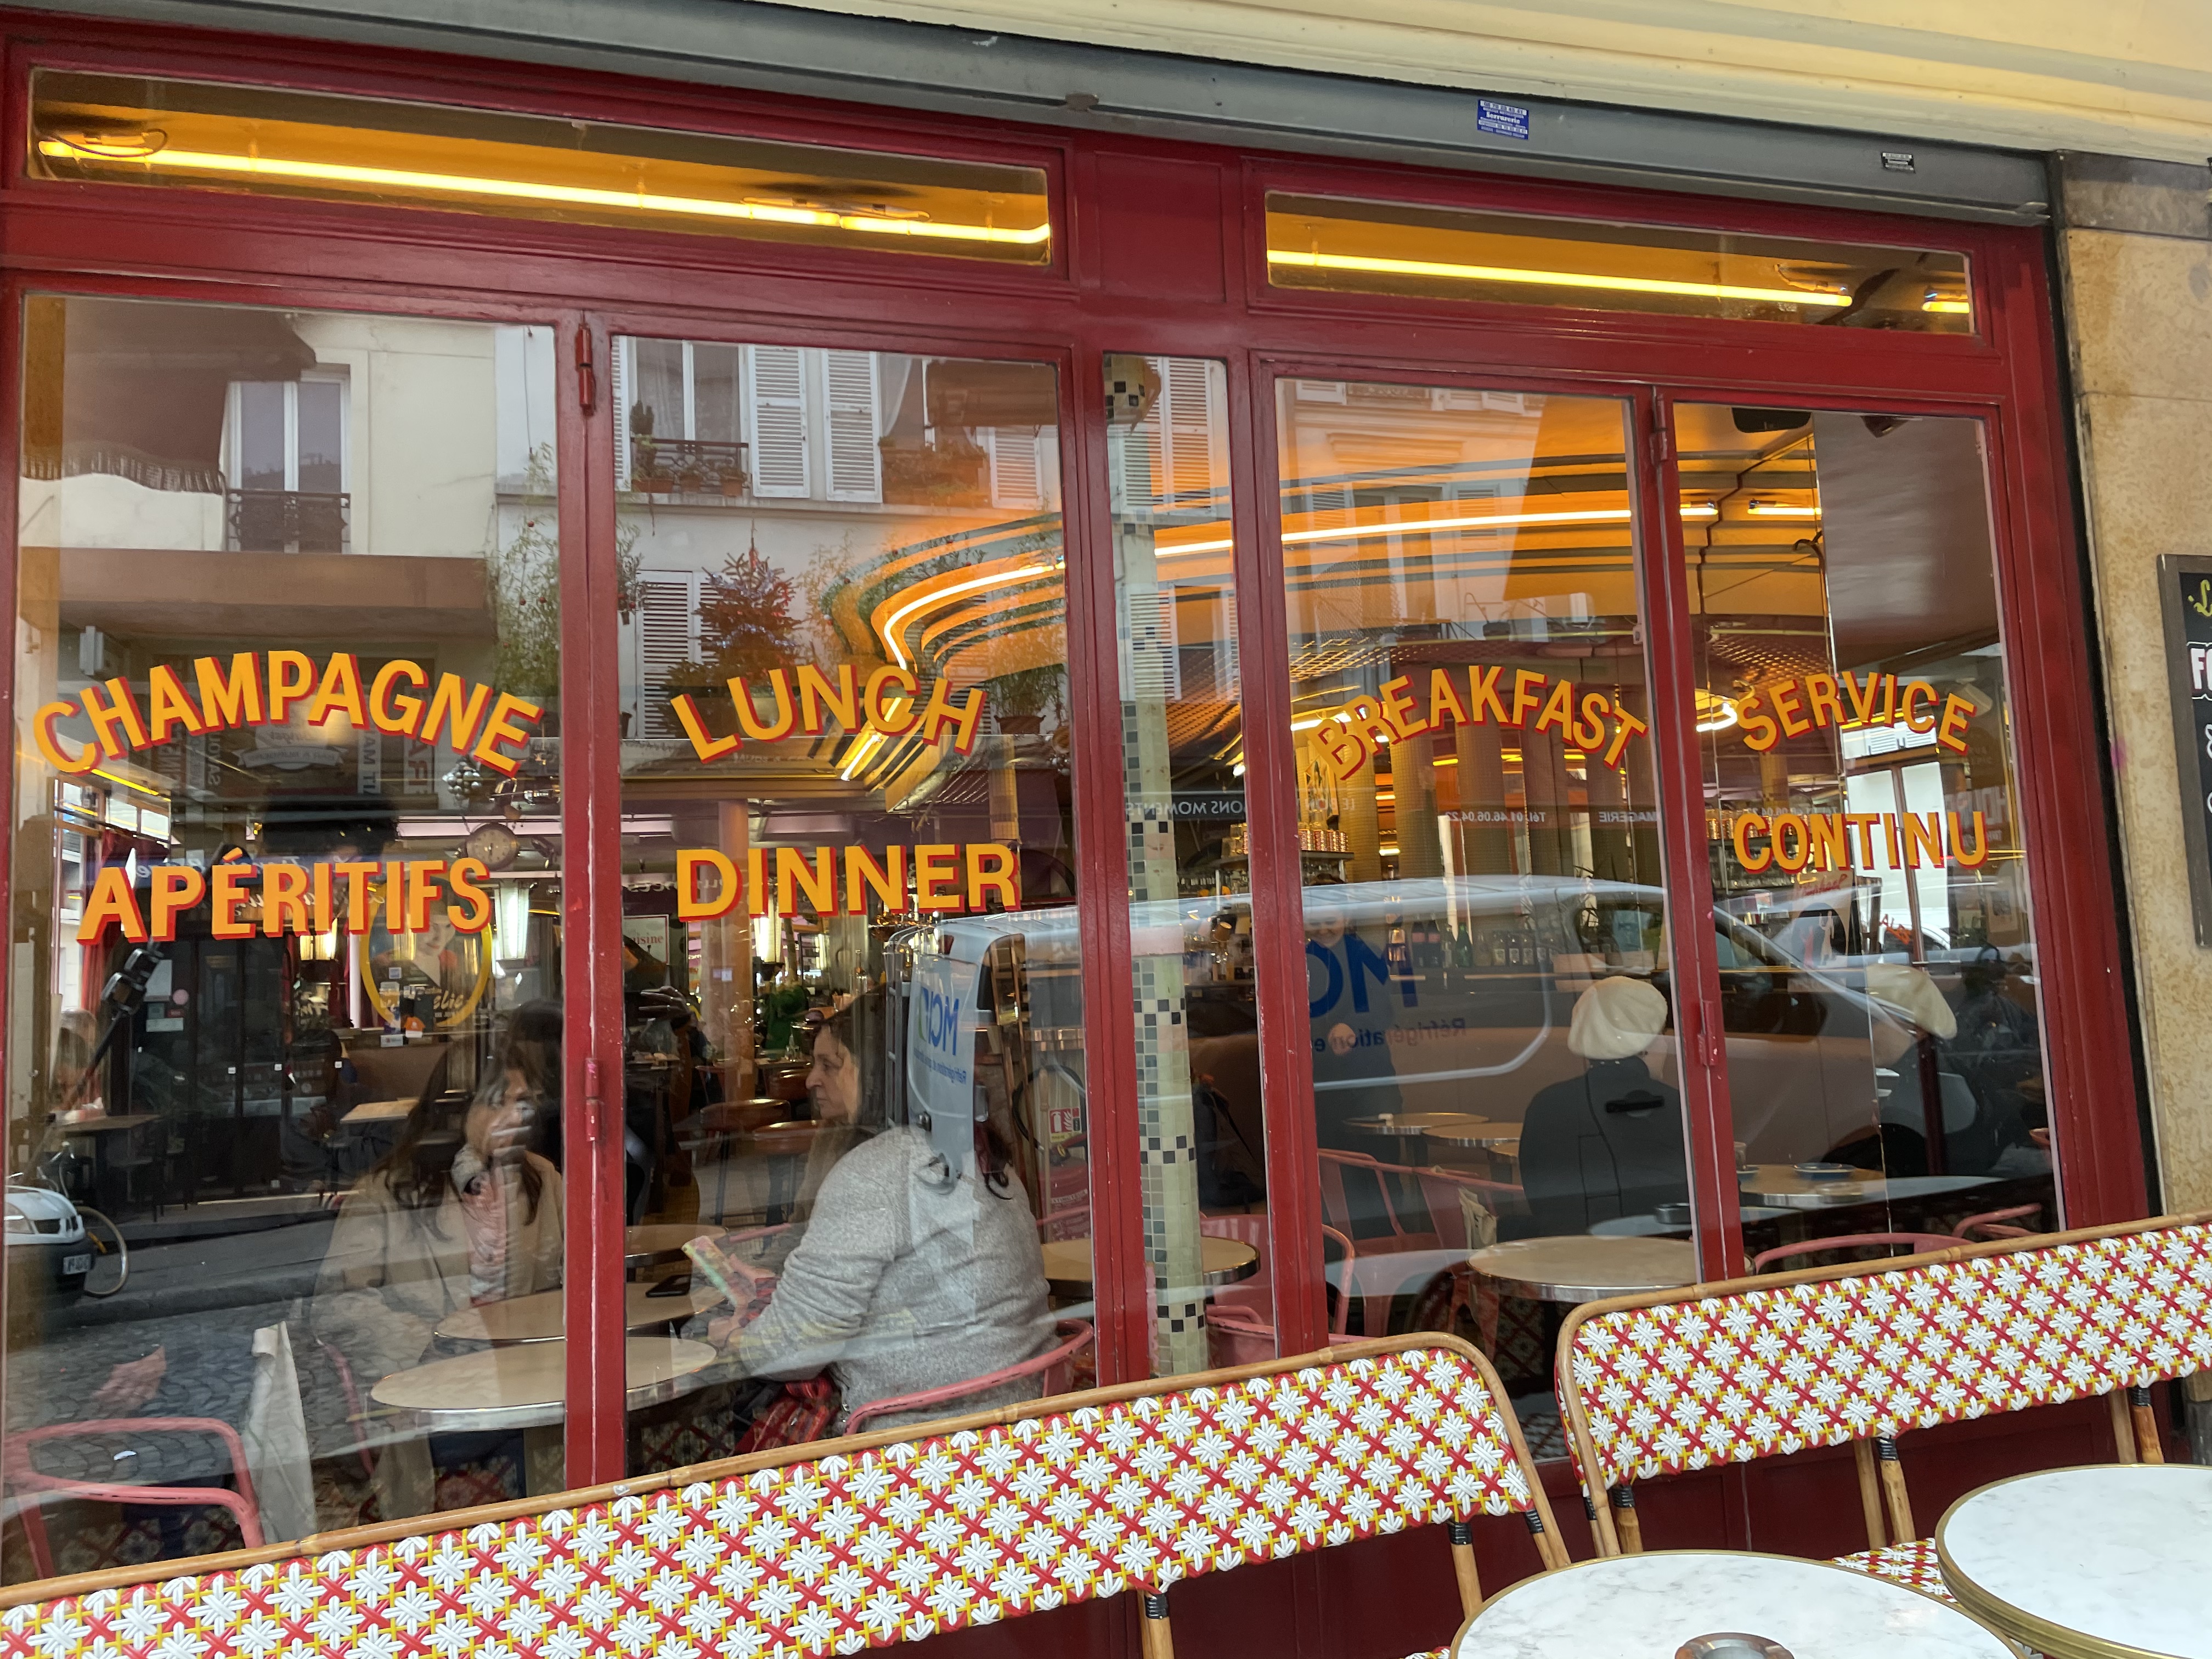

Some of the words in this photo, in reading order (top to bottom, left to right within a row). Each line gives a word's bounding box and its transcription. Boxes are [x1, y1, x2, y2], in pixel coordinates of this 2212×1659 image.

[33, 650, 545, 777] CHAMPAGNE
[670, 664, 987, 764] LUNCH
[1306, 665, 1649, 781] BREAKFAST
[1734, 671, 1976, 755] SERVICE
[676, 843, 1022, 923] DINNER
[1734, 811, 1989, 874] CONTINU
[77, 847, 492, 946] APÉRITIFS
